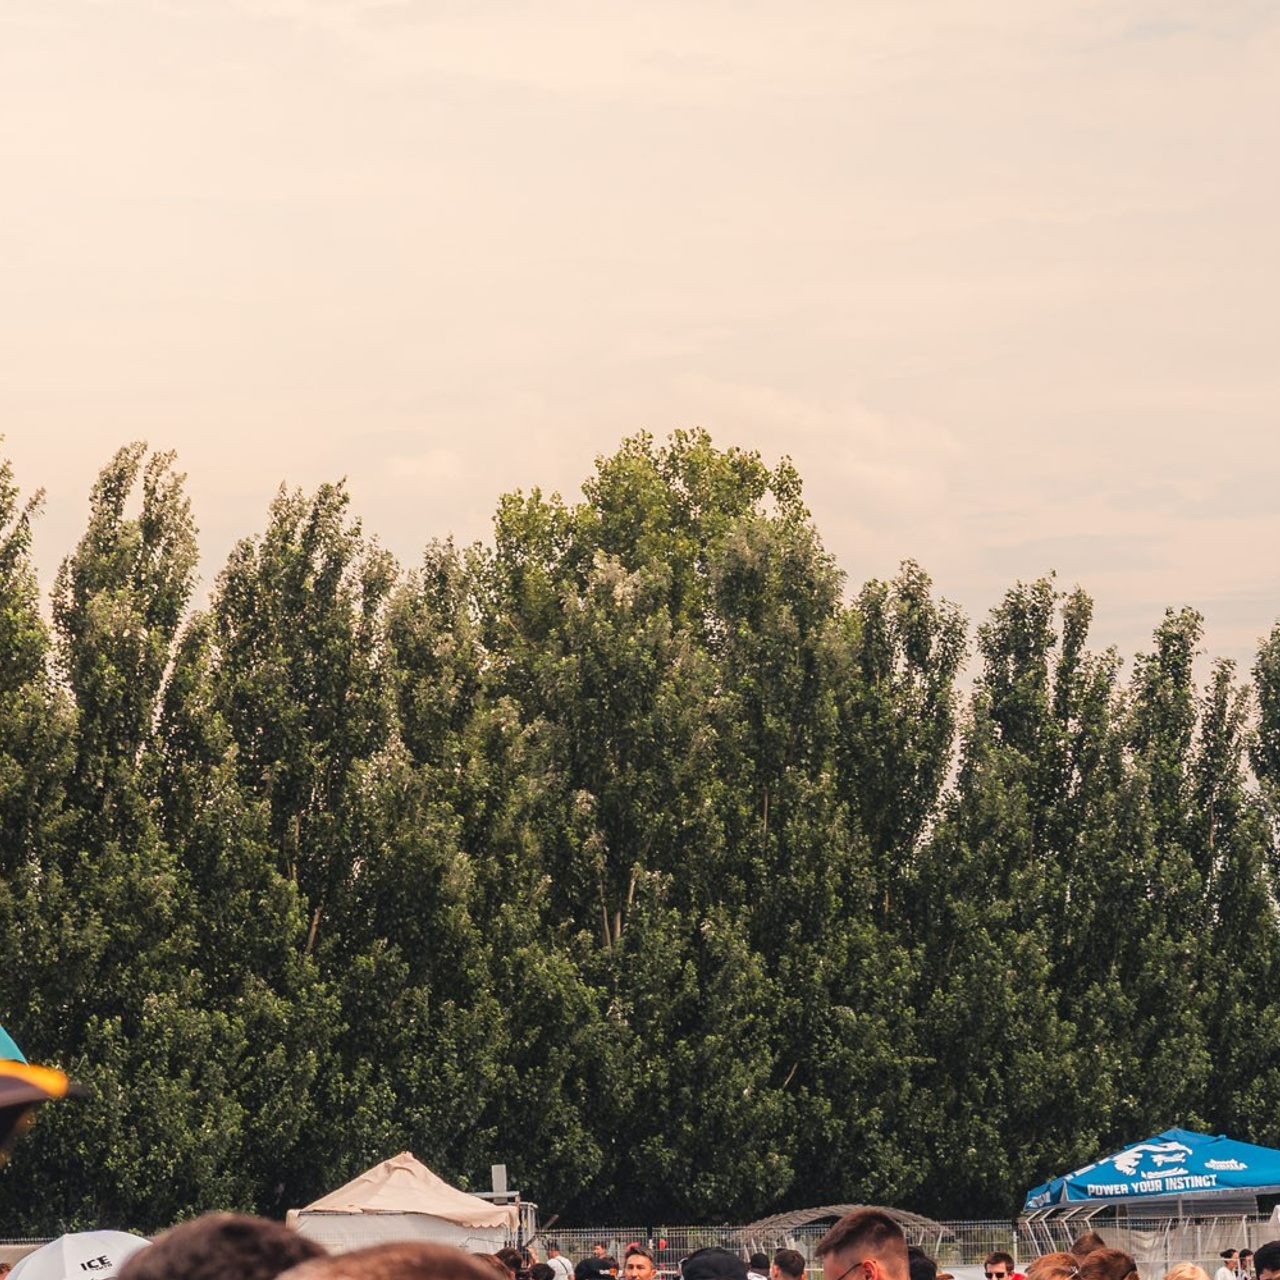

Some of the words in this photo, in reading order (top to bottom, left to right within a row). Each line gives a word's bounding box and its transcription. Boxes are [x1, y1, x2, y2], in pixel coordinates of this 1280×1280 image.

[1087, 1184, 1128, 1196] POWER
[1131, 1180, 1163, 1193] YOUR
[1165, 1174, 1217, 1190] INSTINCT
[80, 1255, 110, 1271] ICE
